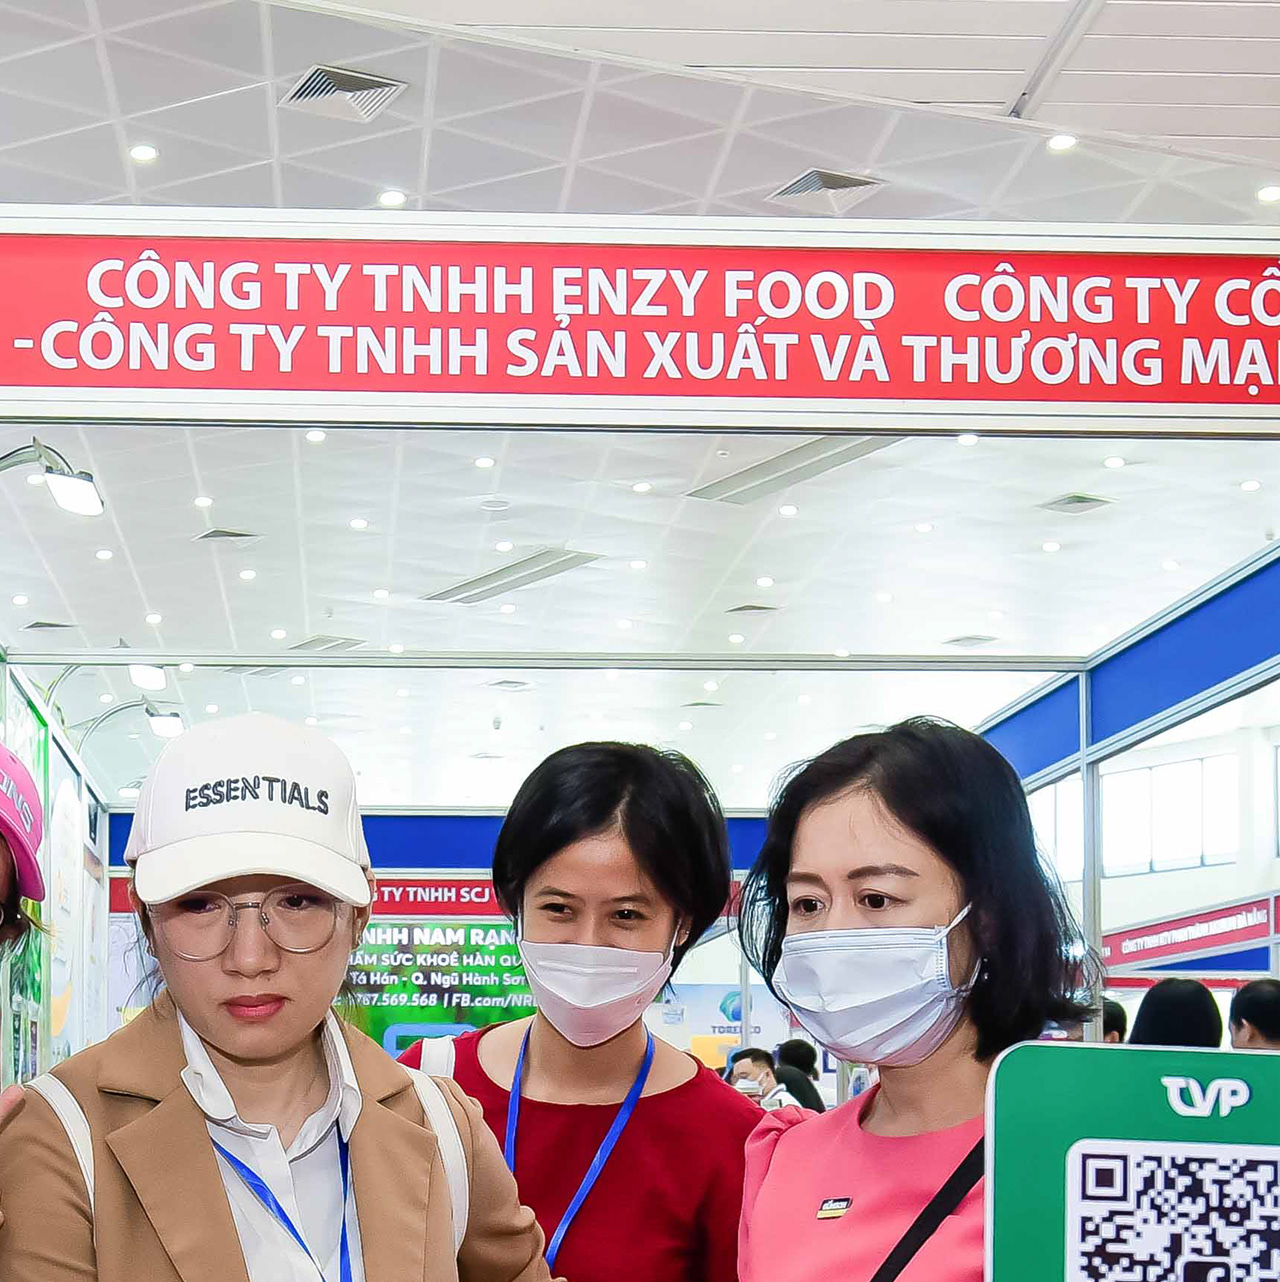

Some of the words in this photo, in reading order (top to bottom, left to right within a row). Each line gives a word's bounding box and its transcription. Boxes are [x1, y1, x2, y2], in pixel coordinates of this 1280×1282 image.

[87, 249, 261, 311] CÔNG
[275, 263, 352, 311] TY
[362, 265, 534, 315] TNHH
[551, 267, 708, 317] ENZY
[724, 269, 896, 321] FOOD
[944, 262, 1114, 324] CÔNG
[1125, 277, 1201, 325] TY
[13, 311, 215, 371] -CÔNG
[228, 324, 305, 372] TY
[316, 327, 488, 375] TNHH
[505, 313, 627, 378] SẢN
[643, 316, 799, 380] XUẤT
[810, 319, 890, 382] VÀ
[901, 328, 1163, 386] THƯƠNG
[184, 775, 329, 816] ESSENTIALS
[381, 887, 401, 902] TY
[406, 887, 456, 902] TNHH
[460, 887, 490, 903] SCJ
[413, 928, 465, 946] NAM
[381, 951, 413, 967] SỨC
[463, 949, 496, 967] HÀN
[370, 972, 398, 985] Hán
[411, 972, 427, 985] Q.
[431, 972, 459, 988] Ngũ
[463, 971, 499, 986] Hành
